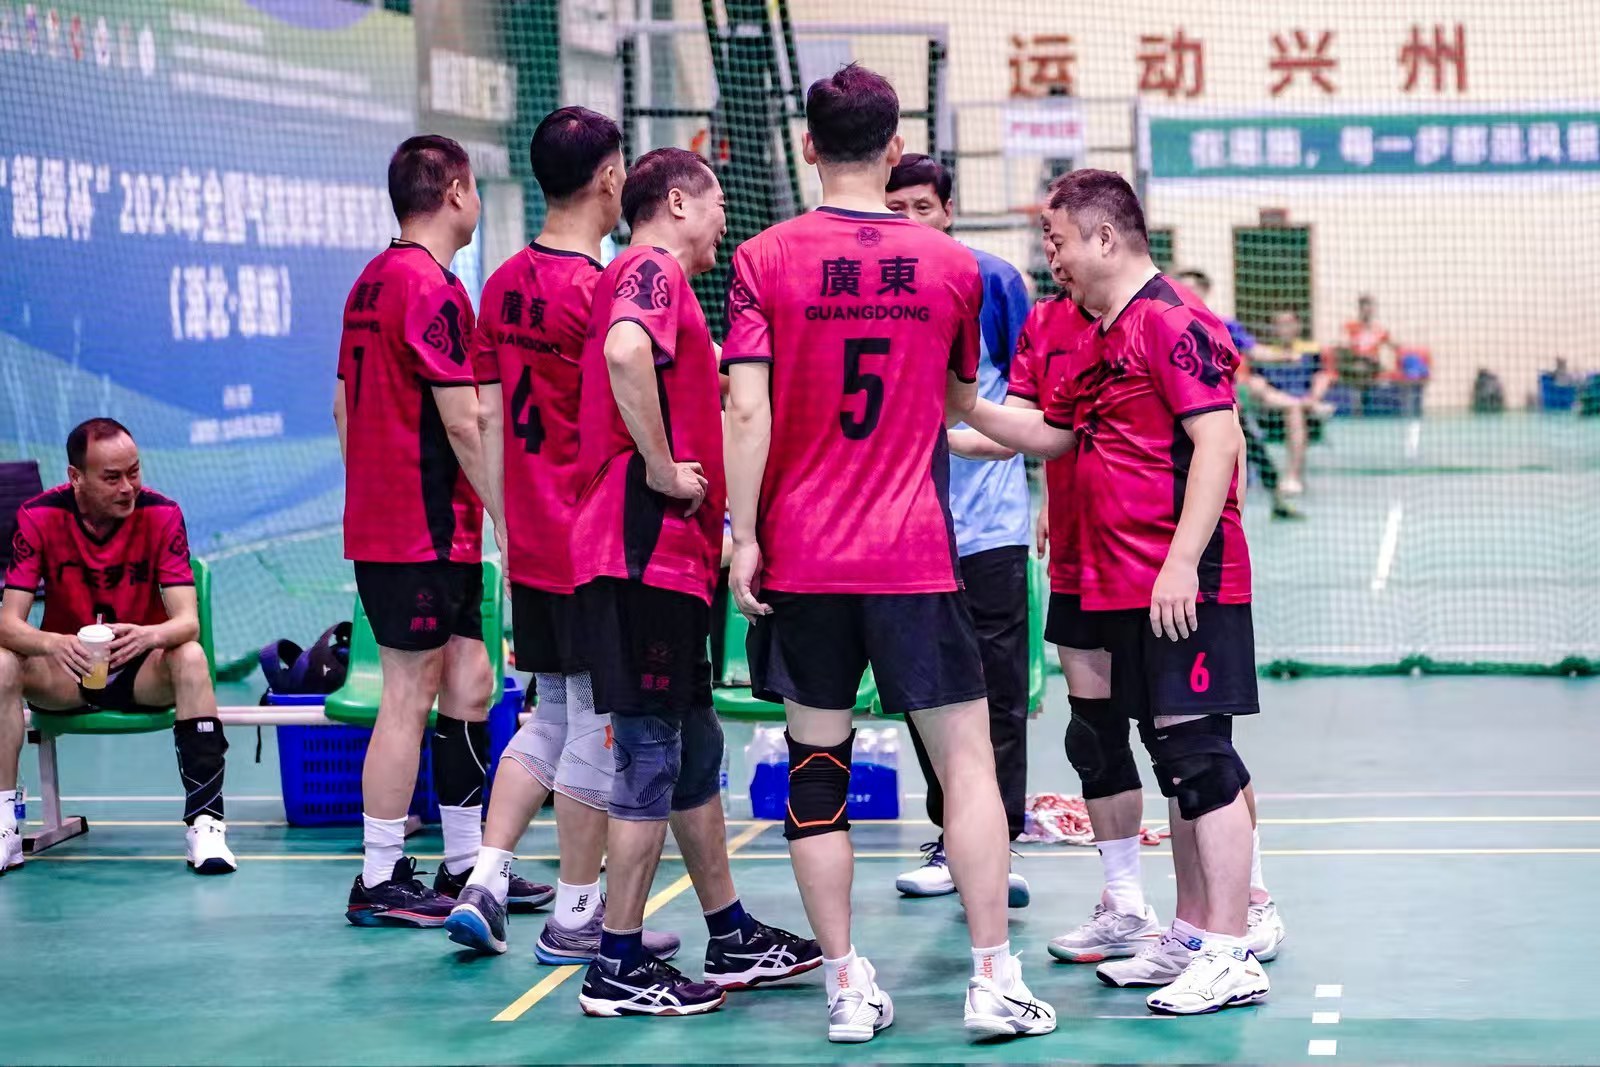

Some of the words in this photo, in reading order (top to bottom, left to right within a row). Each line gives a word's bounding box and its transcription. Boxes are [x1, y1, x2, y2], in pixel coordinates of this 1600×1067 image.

[1008, 24, 1468, 97] 运动兴州
[818, 256, 920, 298] 廣東
[502, 289, 548, 333] 廣東
[804, 305, 930, 322] GUANGDONG
[511, 364, 546, 455] 4
[839, 338, 891, 441] 5
[1190, 652, 1210, 693] 6
